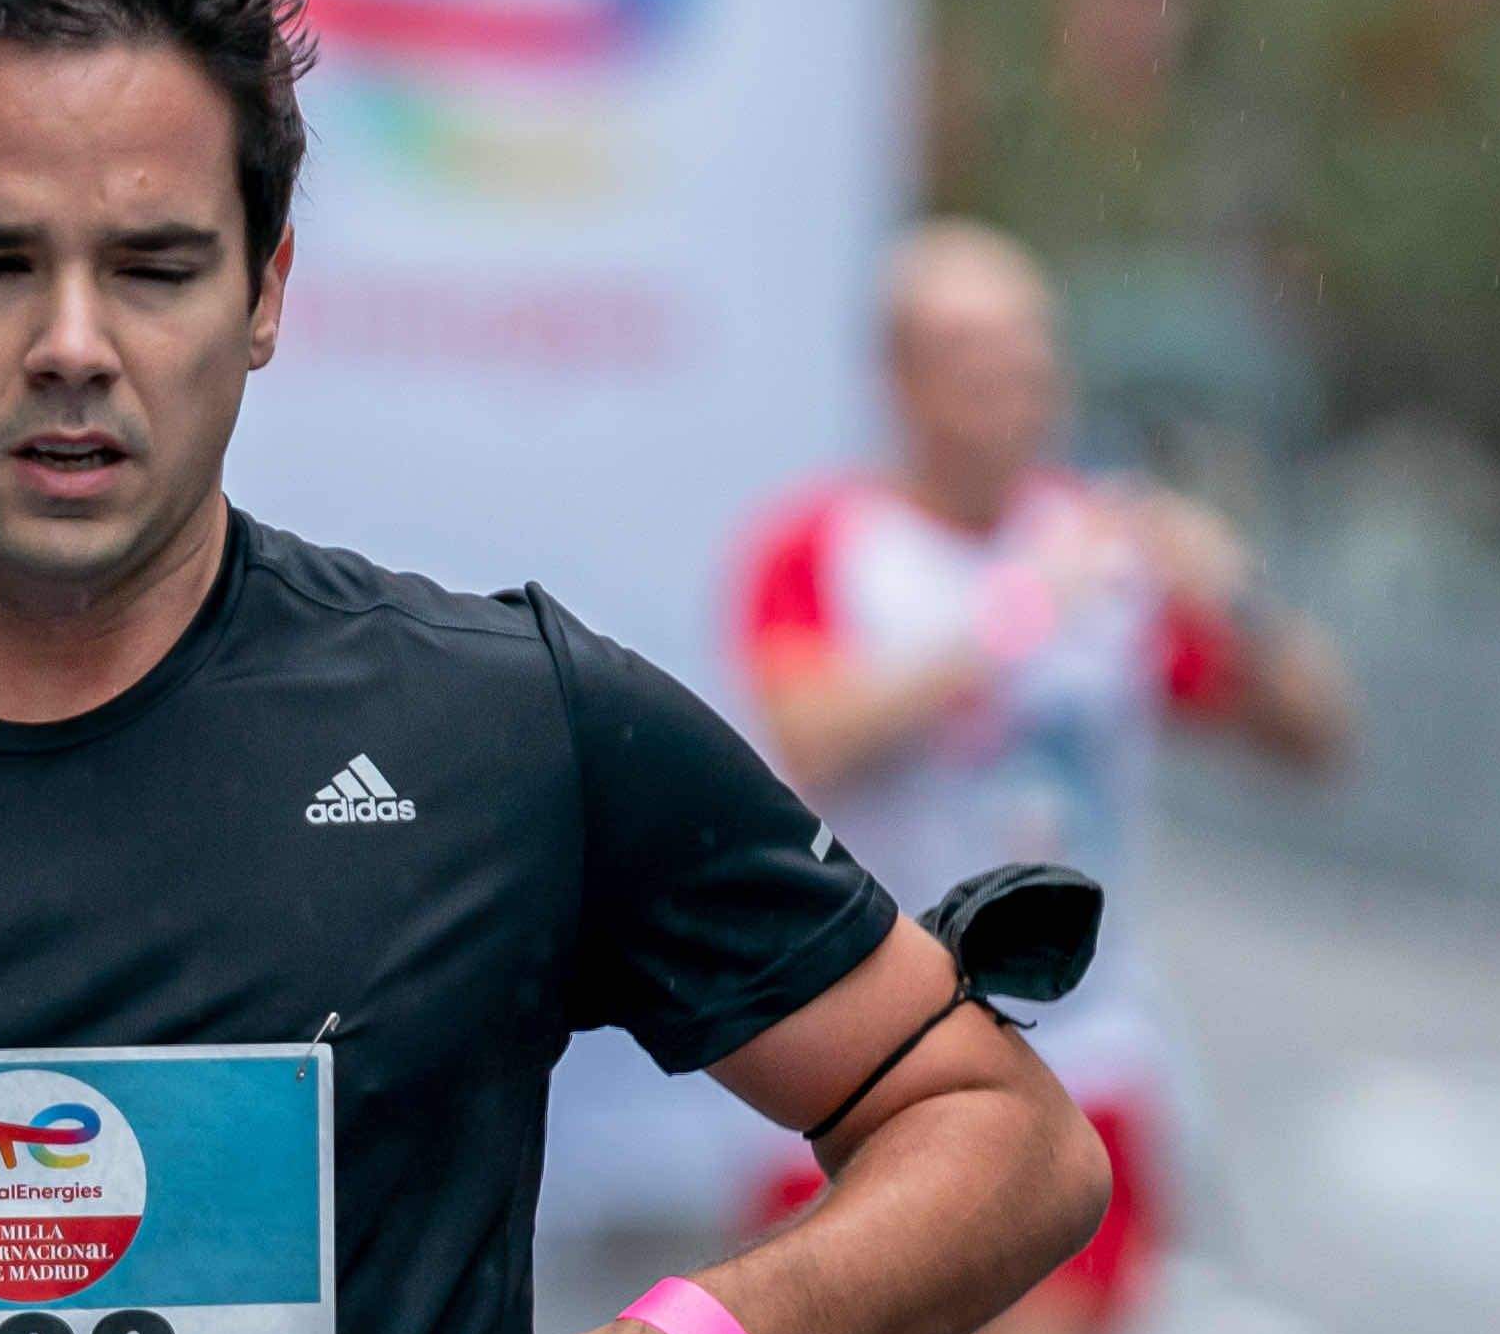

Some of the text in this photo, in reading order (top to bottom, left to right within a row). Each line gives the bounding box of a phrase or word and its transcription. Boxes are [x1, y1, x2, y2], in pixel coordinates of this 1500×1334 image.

[305, 796, 416, 824] adidas
[0, 1224, 65, 1241] MILLA
[10, 1264, 89, 1282] MADRID
